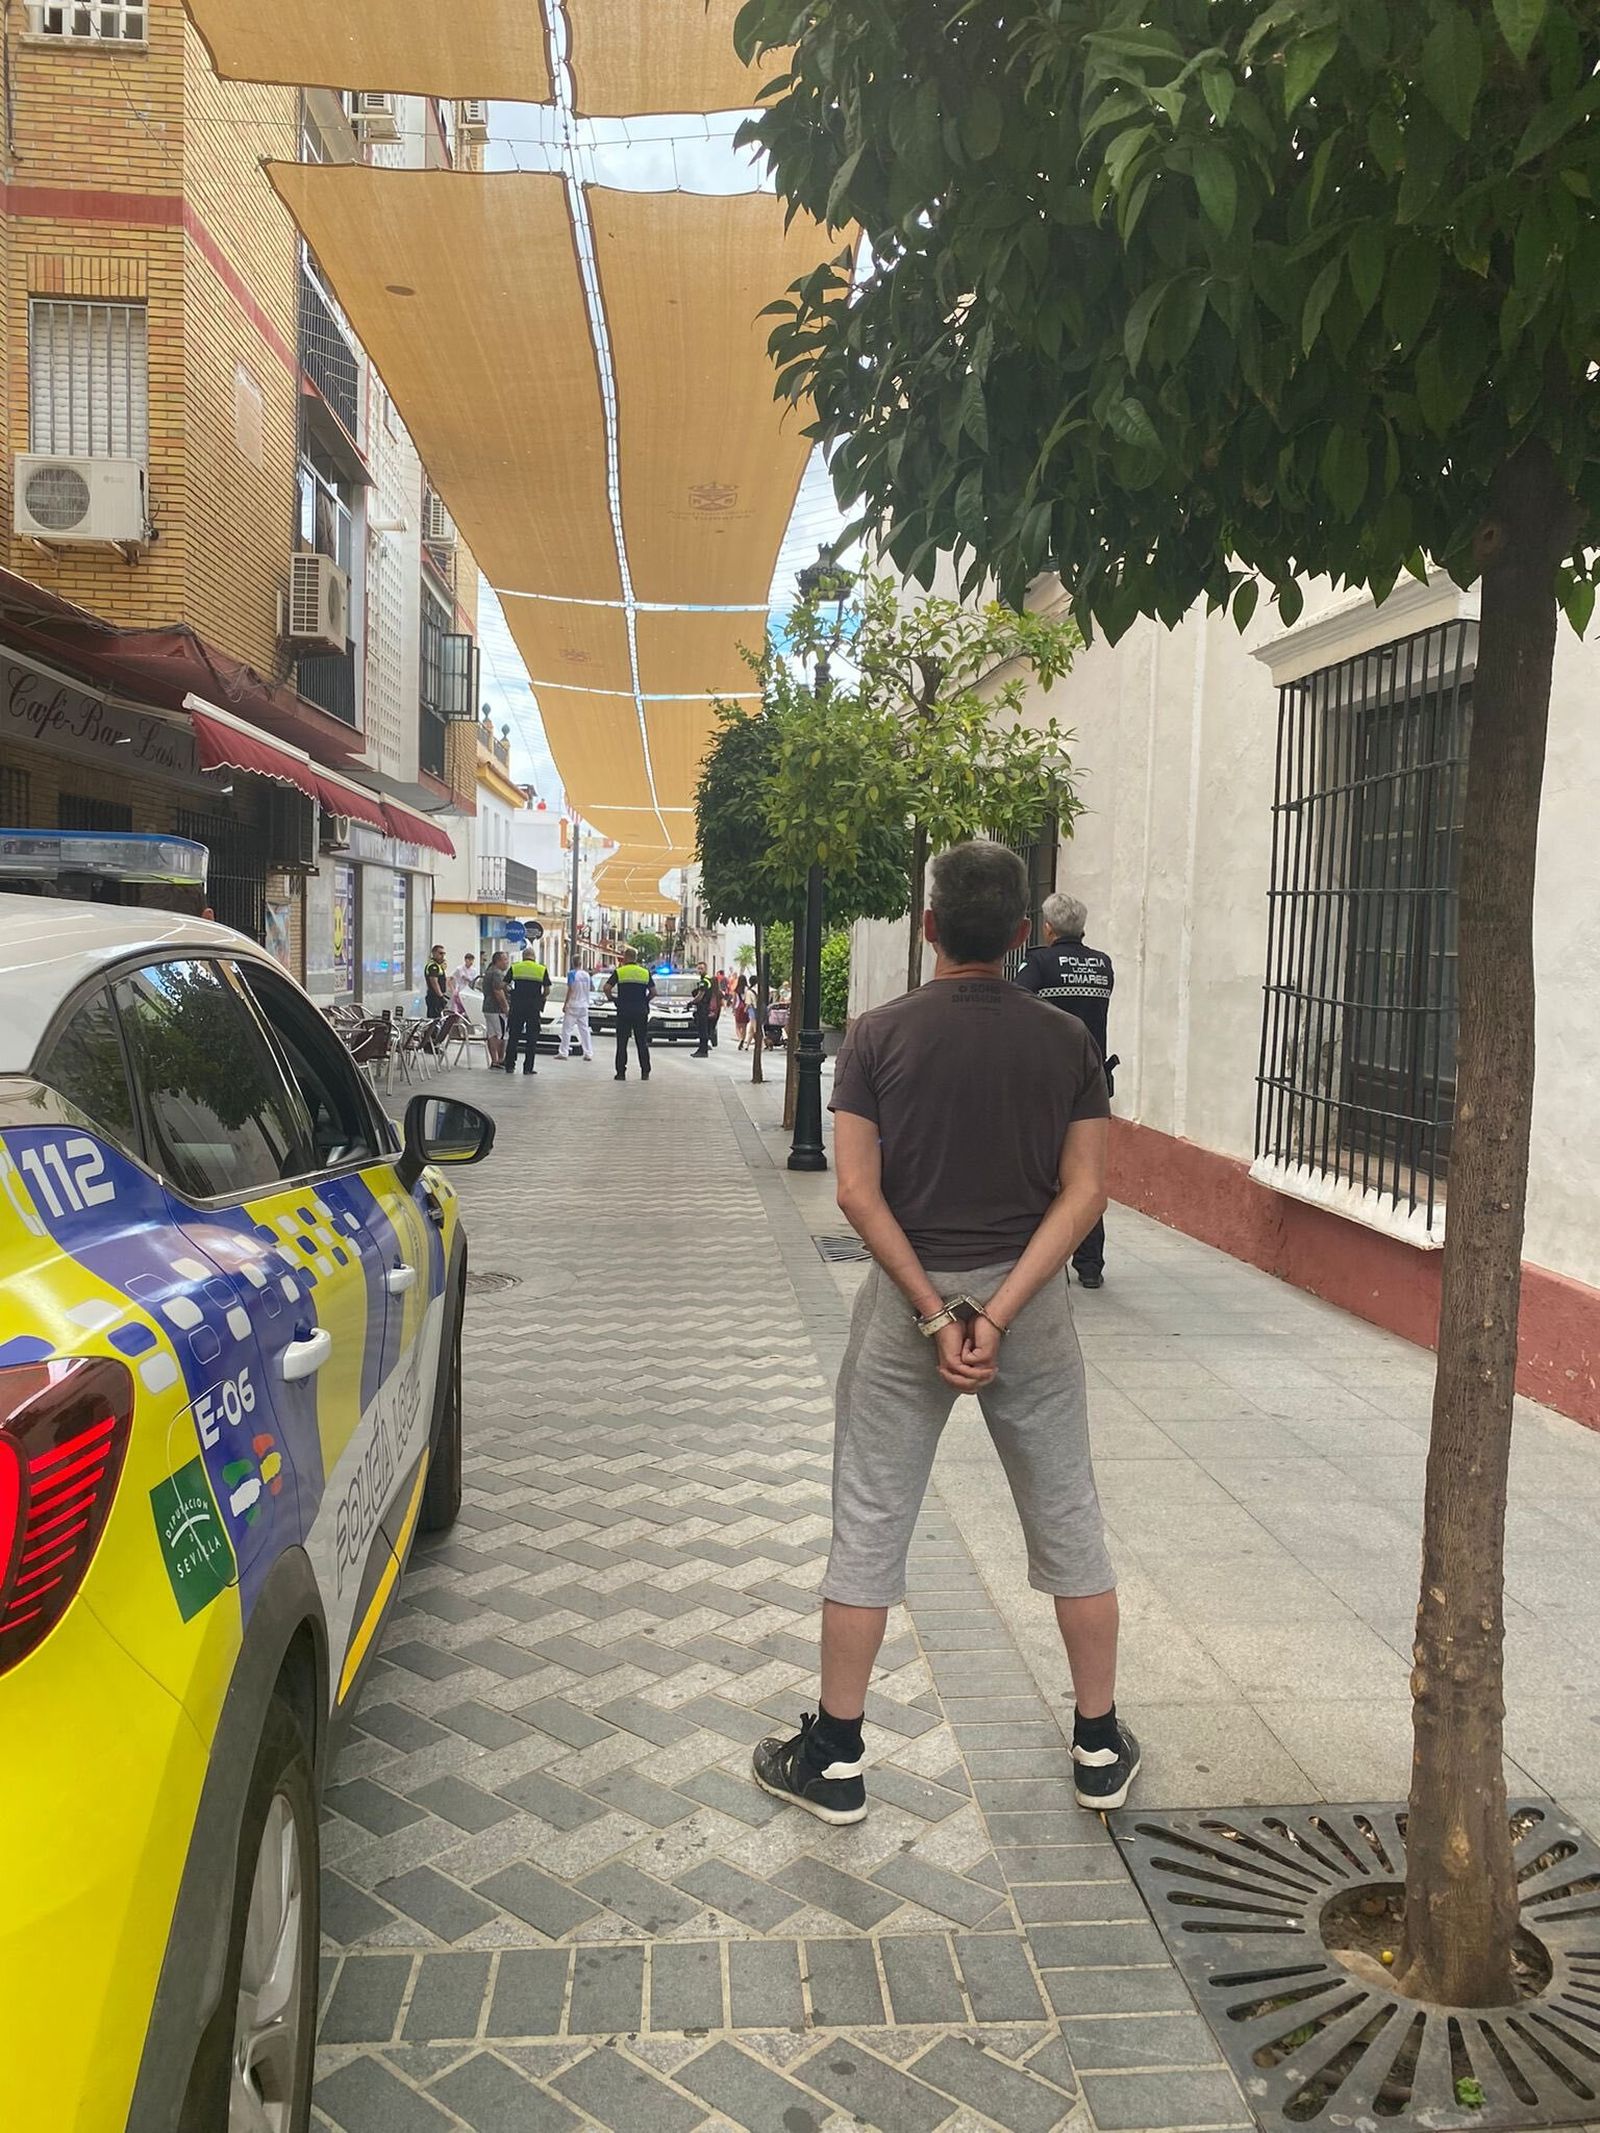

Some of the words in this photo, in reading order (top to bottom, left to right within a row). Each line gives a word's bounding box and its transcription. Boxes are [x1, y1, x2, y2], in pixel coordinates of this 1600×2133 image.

[1058, 956, 1106, 968] POLICIA
[1060, 974, 1109, 986] TOMARES
[21, 1137, 116, 1218] 112
[195, 1366, 255, 1451] E-06
[176, 1535, 222, 1579] SEVILLA
